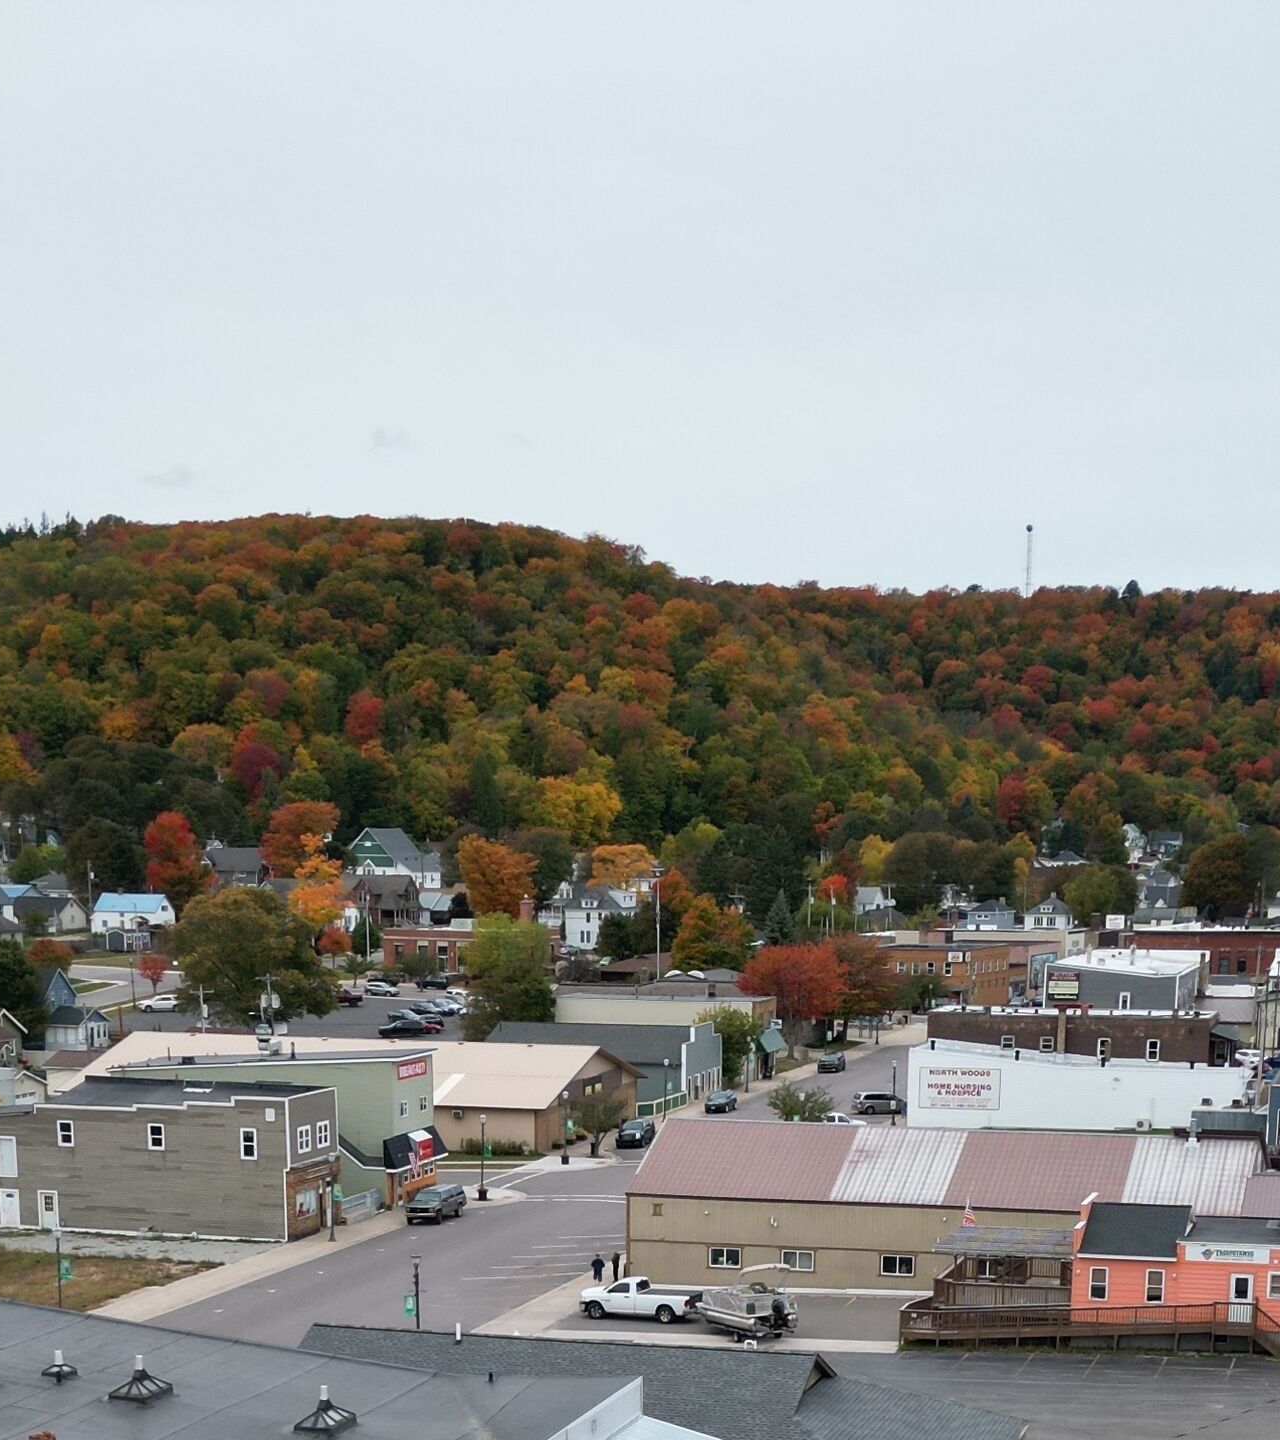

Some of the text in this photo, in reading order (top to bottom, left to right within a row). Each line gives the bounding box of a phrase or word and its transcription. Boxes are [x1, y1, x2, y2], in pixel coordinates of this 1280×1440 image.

[960, 1069, 991, 1077] WOODS
[927, 1082, 992, 1091] HOME NURSING
[944, 1089, 982, 1097] HOSPICE
